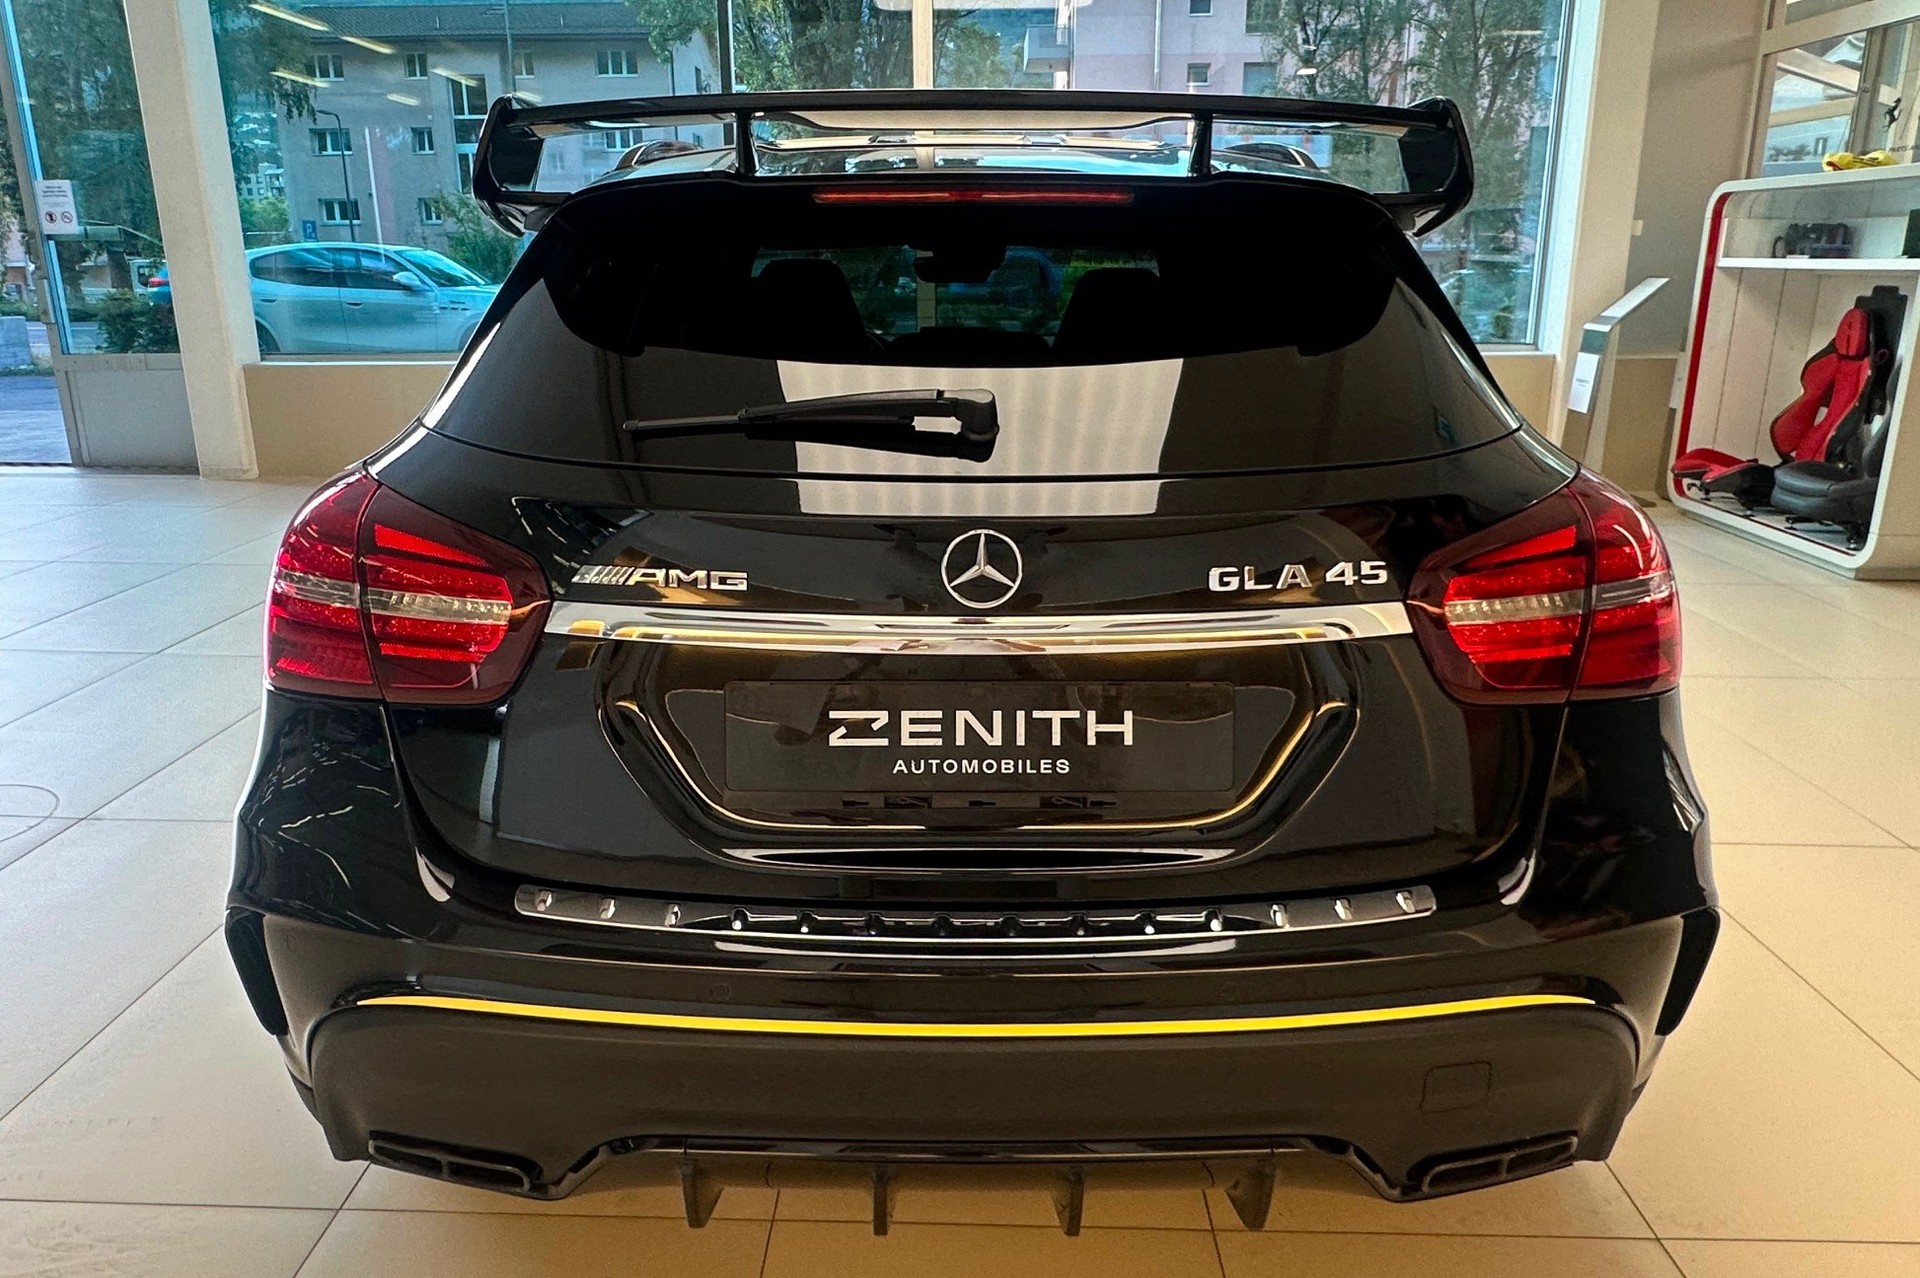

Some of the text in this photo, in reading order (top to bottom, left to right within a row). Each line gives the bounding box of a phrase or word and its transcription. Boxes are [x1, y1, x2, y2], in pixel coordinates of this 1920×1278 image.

[624, 567, 748, 592] AMG
[1208, 560, 1388, 592] GLA 45
[828, 710, 1134, 747] ZENITH
[892, 758, 1071, 775] AUTOMOBILES
